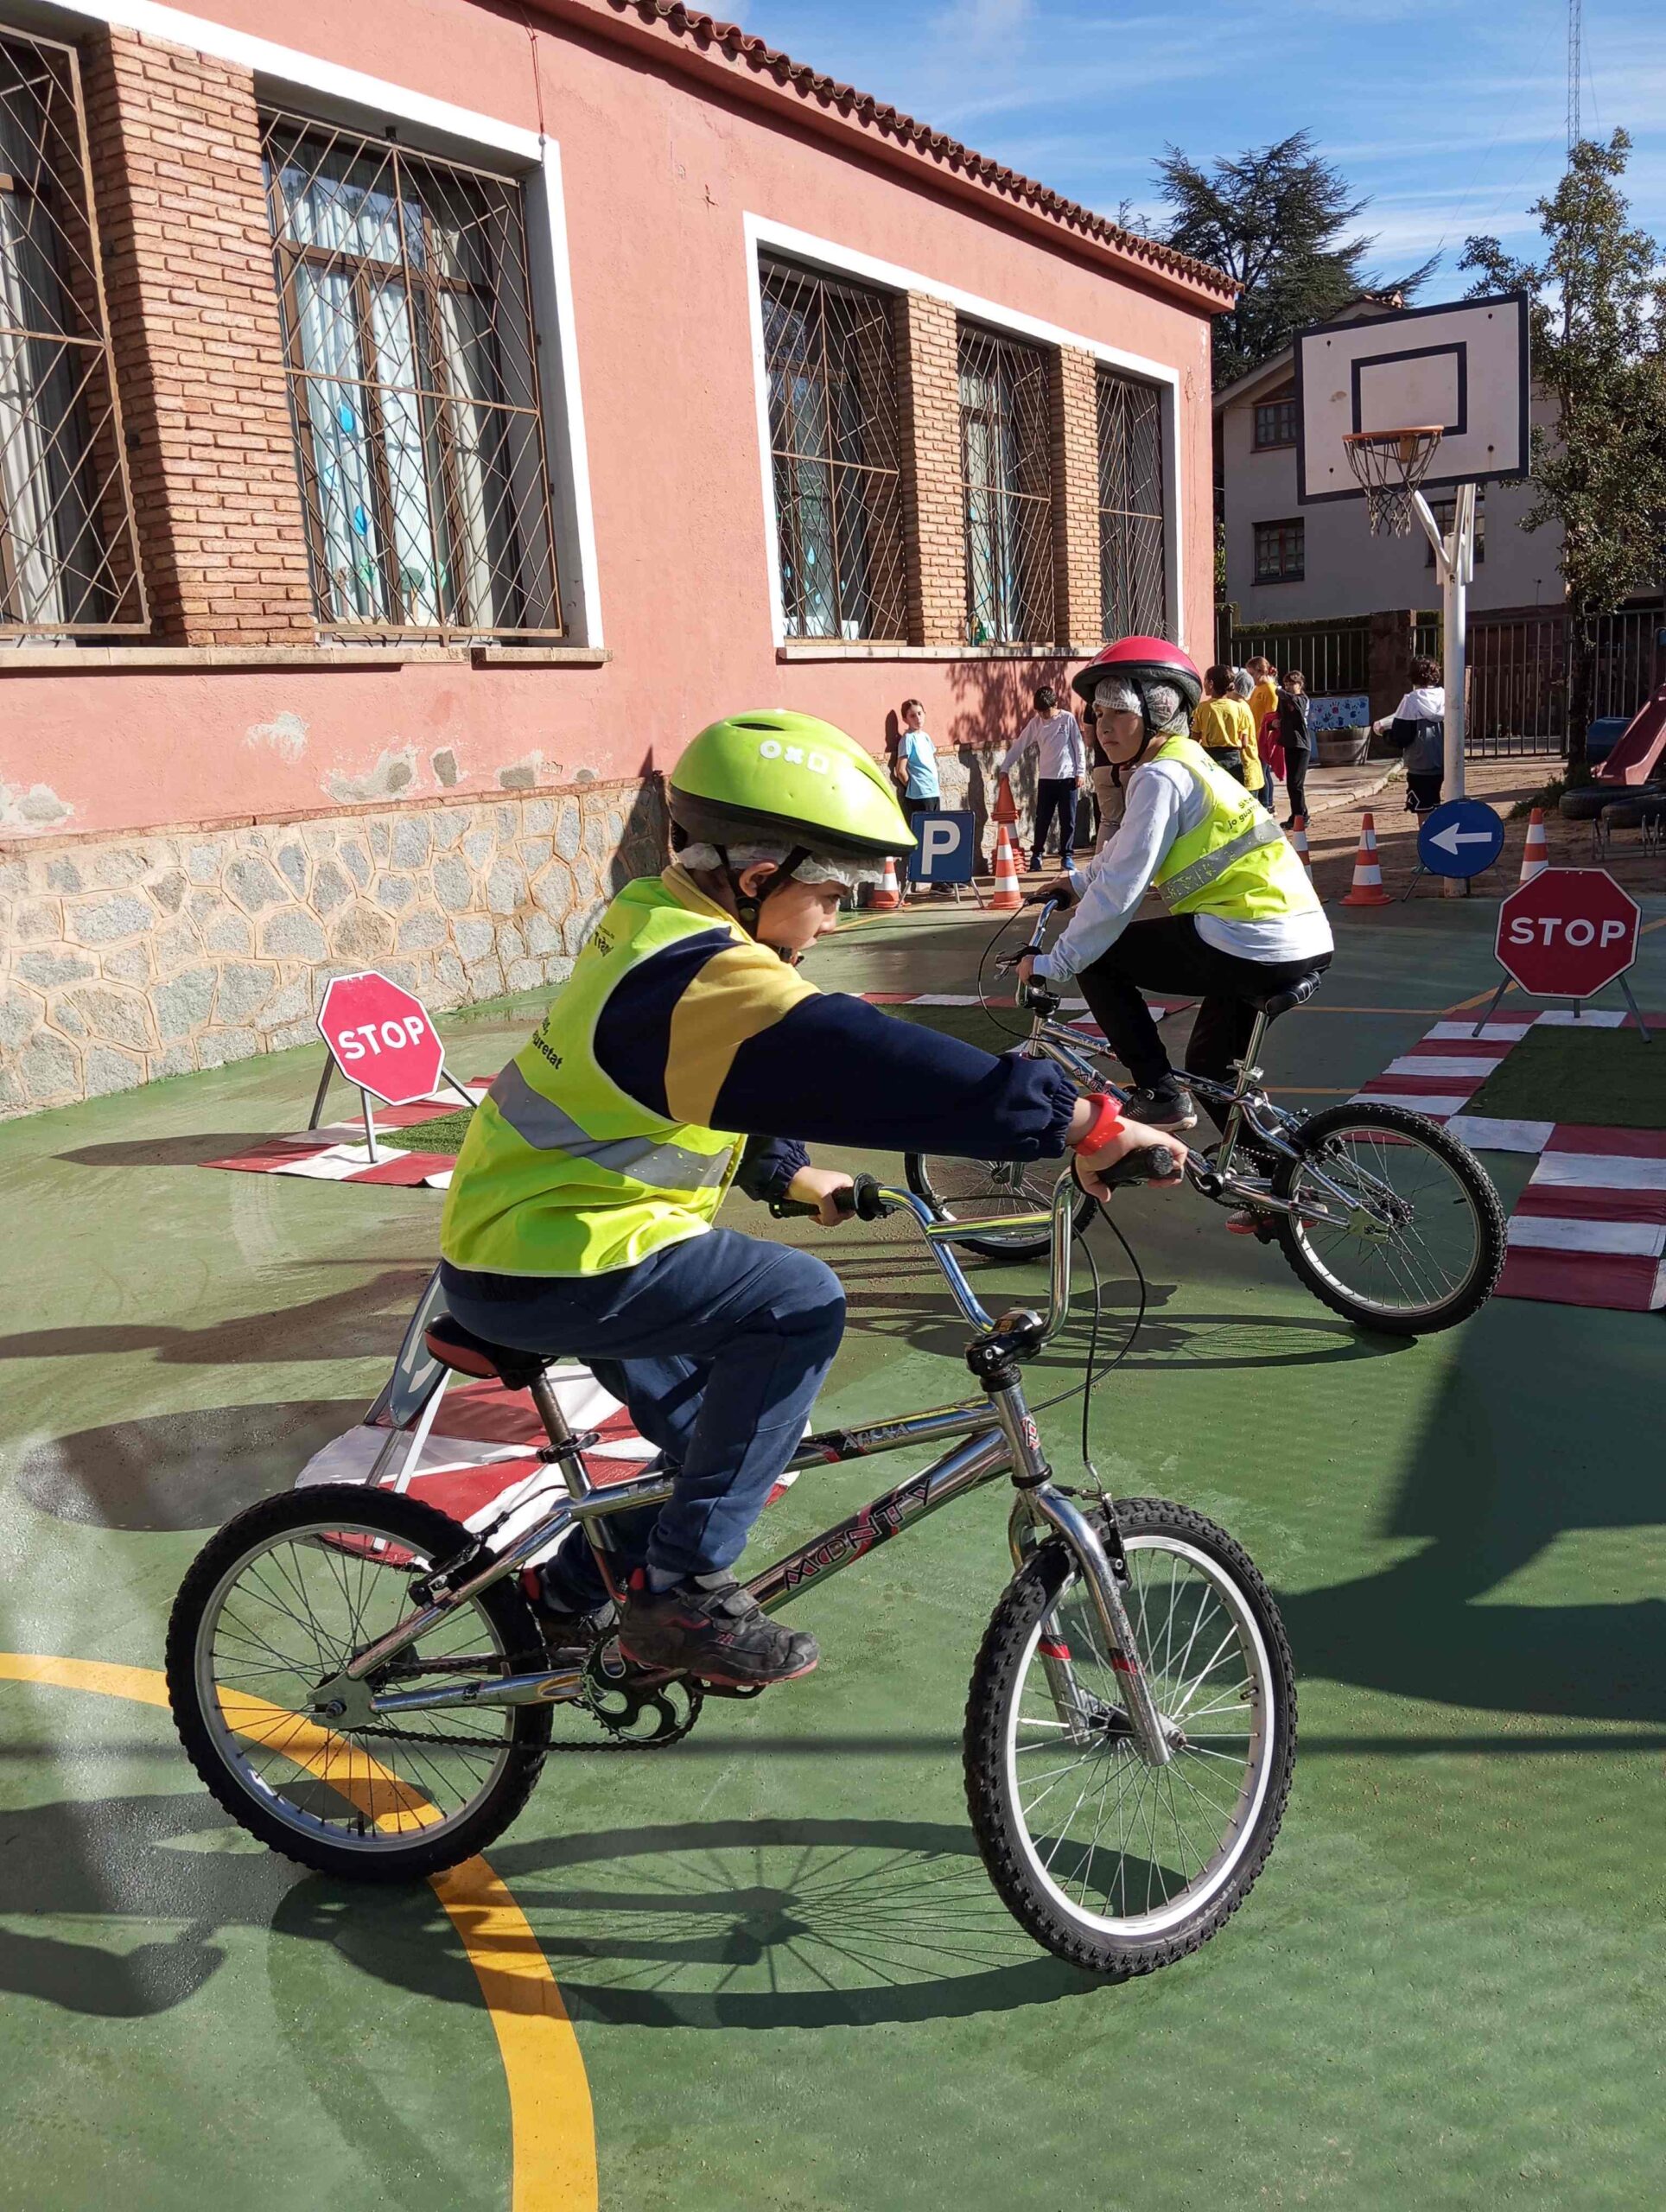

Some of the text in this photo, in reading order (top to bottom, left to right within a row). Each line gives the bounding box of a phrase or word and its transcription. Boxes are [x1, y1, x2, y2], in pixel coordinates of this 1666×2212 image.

[921, 820, 961, 875] P
[1509, 917, 1626, 948] STOP
[338, 1015, 424, 1059] STOP
[785, 1478, 932, 1591] MONTY
